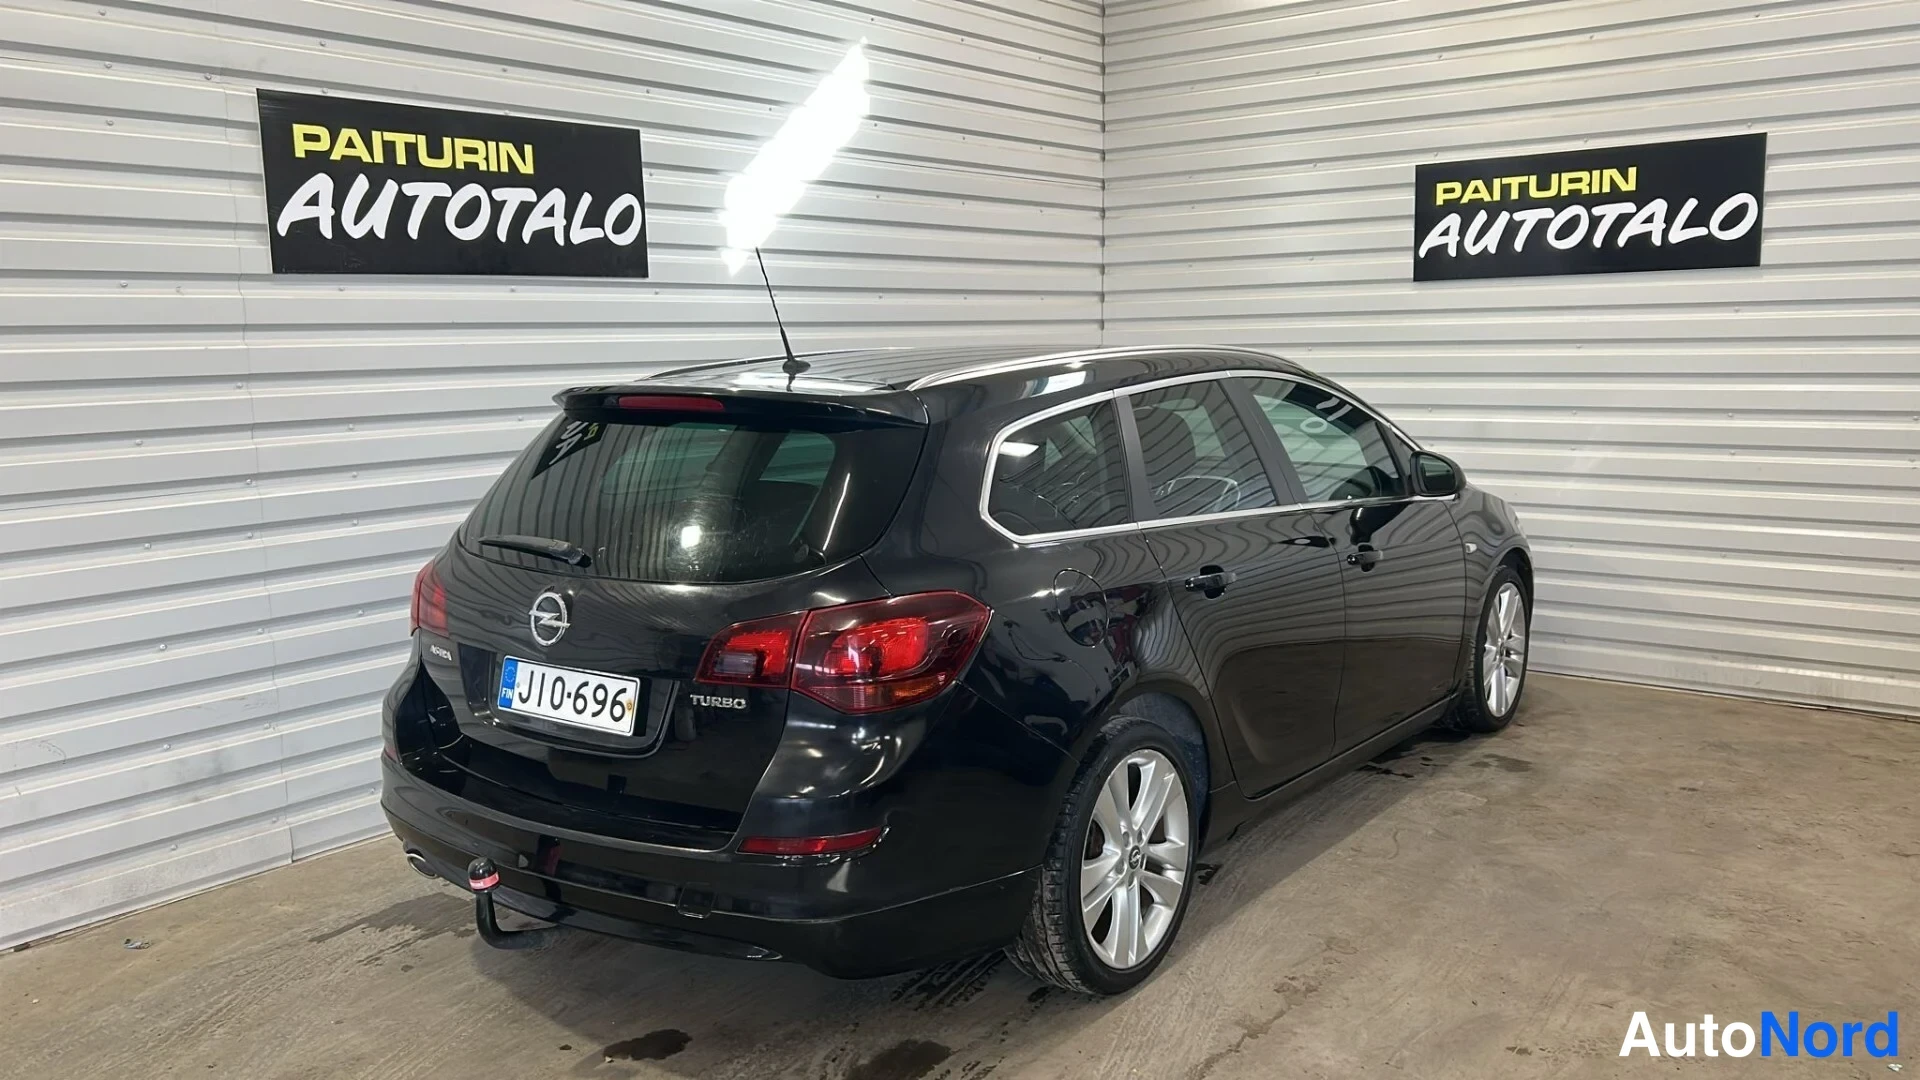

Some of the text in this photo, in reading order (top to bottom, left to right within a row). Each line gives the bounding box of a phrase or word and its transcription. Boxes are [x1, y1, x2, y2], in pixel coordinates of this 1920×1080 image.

[292, 123, 534, 175] PAITURIN
[277, 172, 642, 247] AUTOTALO
[1436, 167, 1637, 206] PAITURIN
[1418, 192, 1759, 258] AUTOTALO
[501, 687, 514, 700] FIN
[518, 670, 627, 722] JIO-696
[690, 694, 746, 709] TURBO
